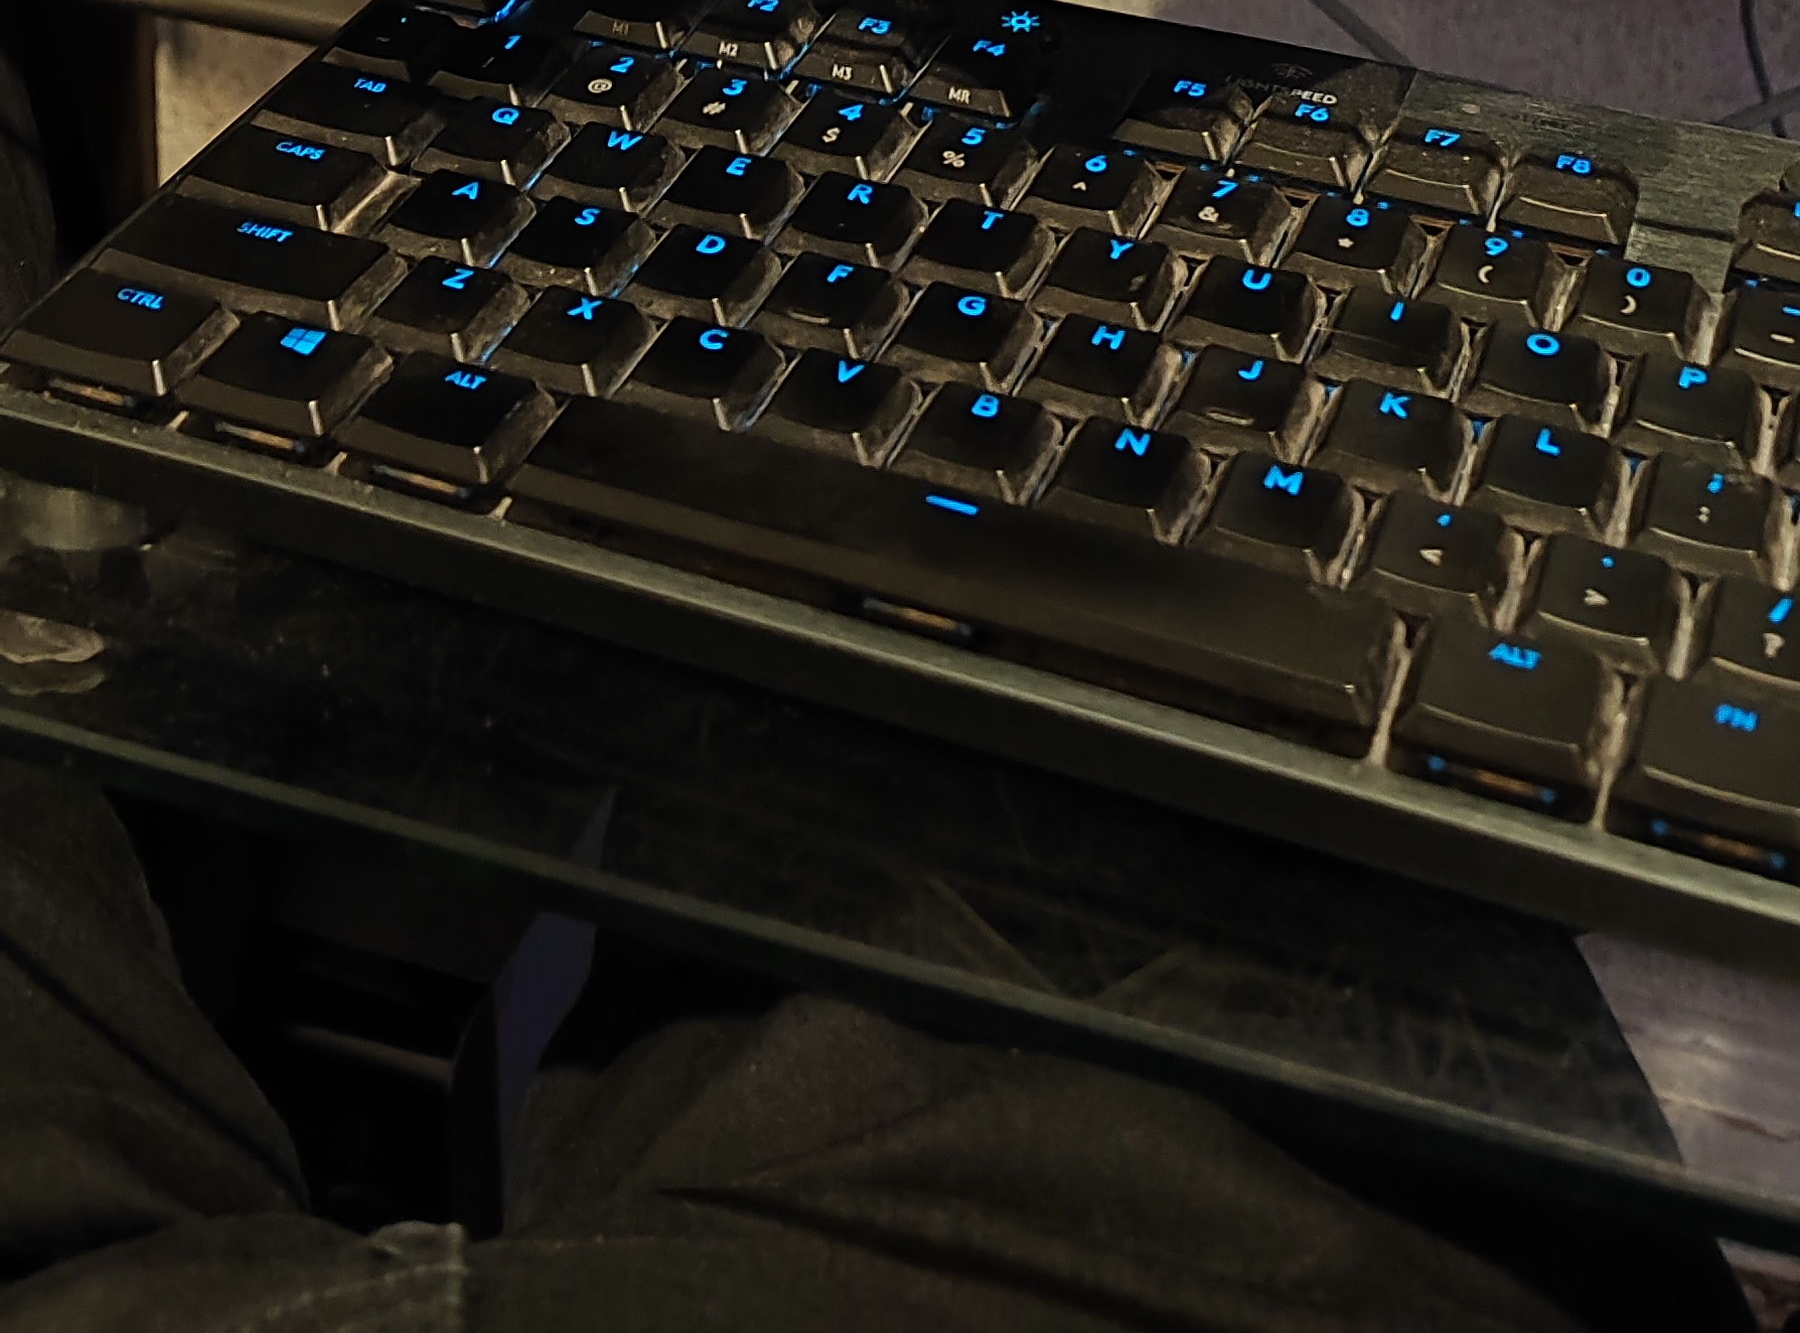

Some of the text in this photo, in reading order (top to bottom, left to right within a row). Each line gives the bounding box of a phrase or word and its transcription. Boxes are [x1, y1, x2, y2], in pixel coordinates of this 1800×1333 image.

[858, 17, 891, 35] F3
[504, 35, 522, 50] 1
[718, 40, 738, 57] M2
[972, 39, 1006, 57] F4
[609, 56, 635, 74] 2
[722, 78, 748, 96] 3
[1173, 79, 1207, 97] F5
[491, 107, 520, 126] Q
[838, 104, 864, 122] 4
[1294, 103, 1330, 122] F6
[607, 131, 643, 151] W
[961, 127, 986, 146] 5
[1424, 129, 1461, 147] F7
[275, 141, 325, 160] CAPS
[725, 156, 752, 177] E
[1085, 154, 1107, 173] 6
[1556, 154, 1591, 174] F8
[451, 181, 479, 201] A
[847, 183, 873, 205] R
[1212, 180, 1238, 199] 7
[574, 208, 601, 226] S
[1345, 208, 1370, 227] 8
[237, 222, 293, 243] SHIFT
[695, 234, 726, 255] D
[1110, 239, 1134, 260] Y
[1484, 237, 1509, 256] 9
[441, 268, 474, 290] Z
[826, 264, 854, 283] F
[1242, 269, 1272, 291] U
[1626, 267, 1651, 288] 0
[117, 288, 164, 310] CTRL
[567, 297, 603, 321] X
[957, 295, 987, 316] G
[699, 328, 729, 350] C
[1091, 325, 1126, 350] H
[1526, 333, 1560, 356] O
[445, 370, 487, 390] ALT
[837, 360, 865, 383] V
[1238, 360, 1264, 381] J
[1678, 366, 1707, 389] P
[971, 394, 1000, 418] B
[1379, 392, 1410, 419] K
[1114, 428, 1151, 457] N
[1535, 429, 1561, 456] L
[1263, 465, 1303, 496] M
[1489, 643, 1541, 670] ALT
